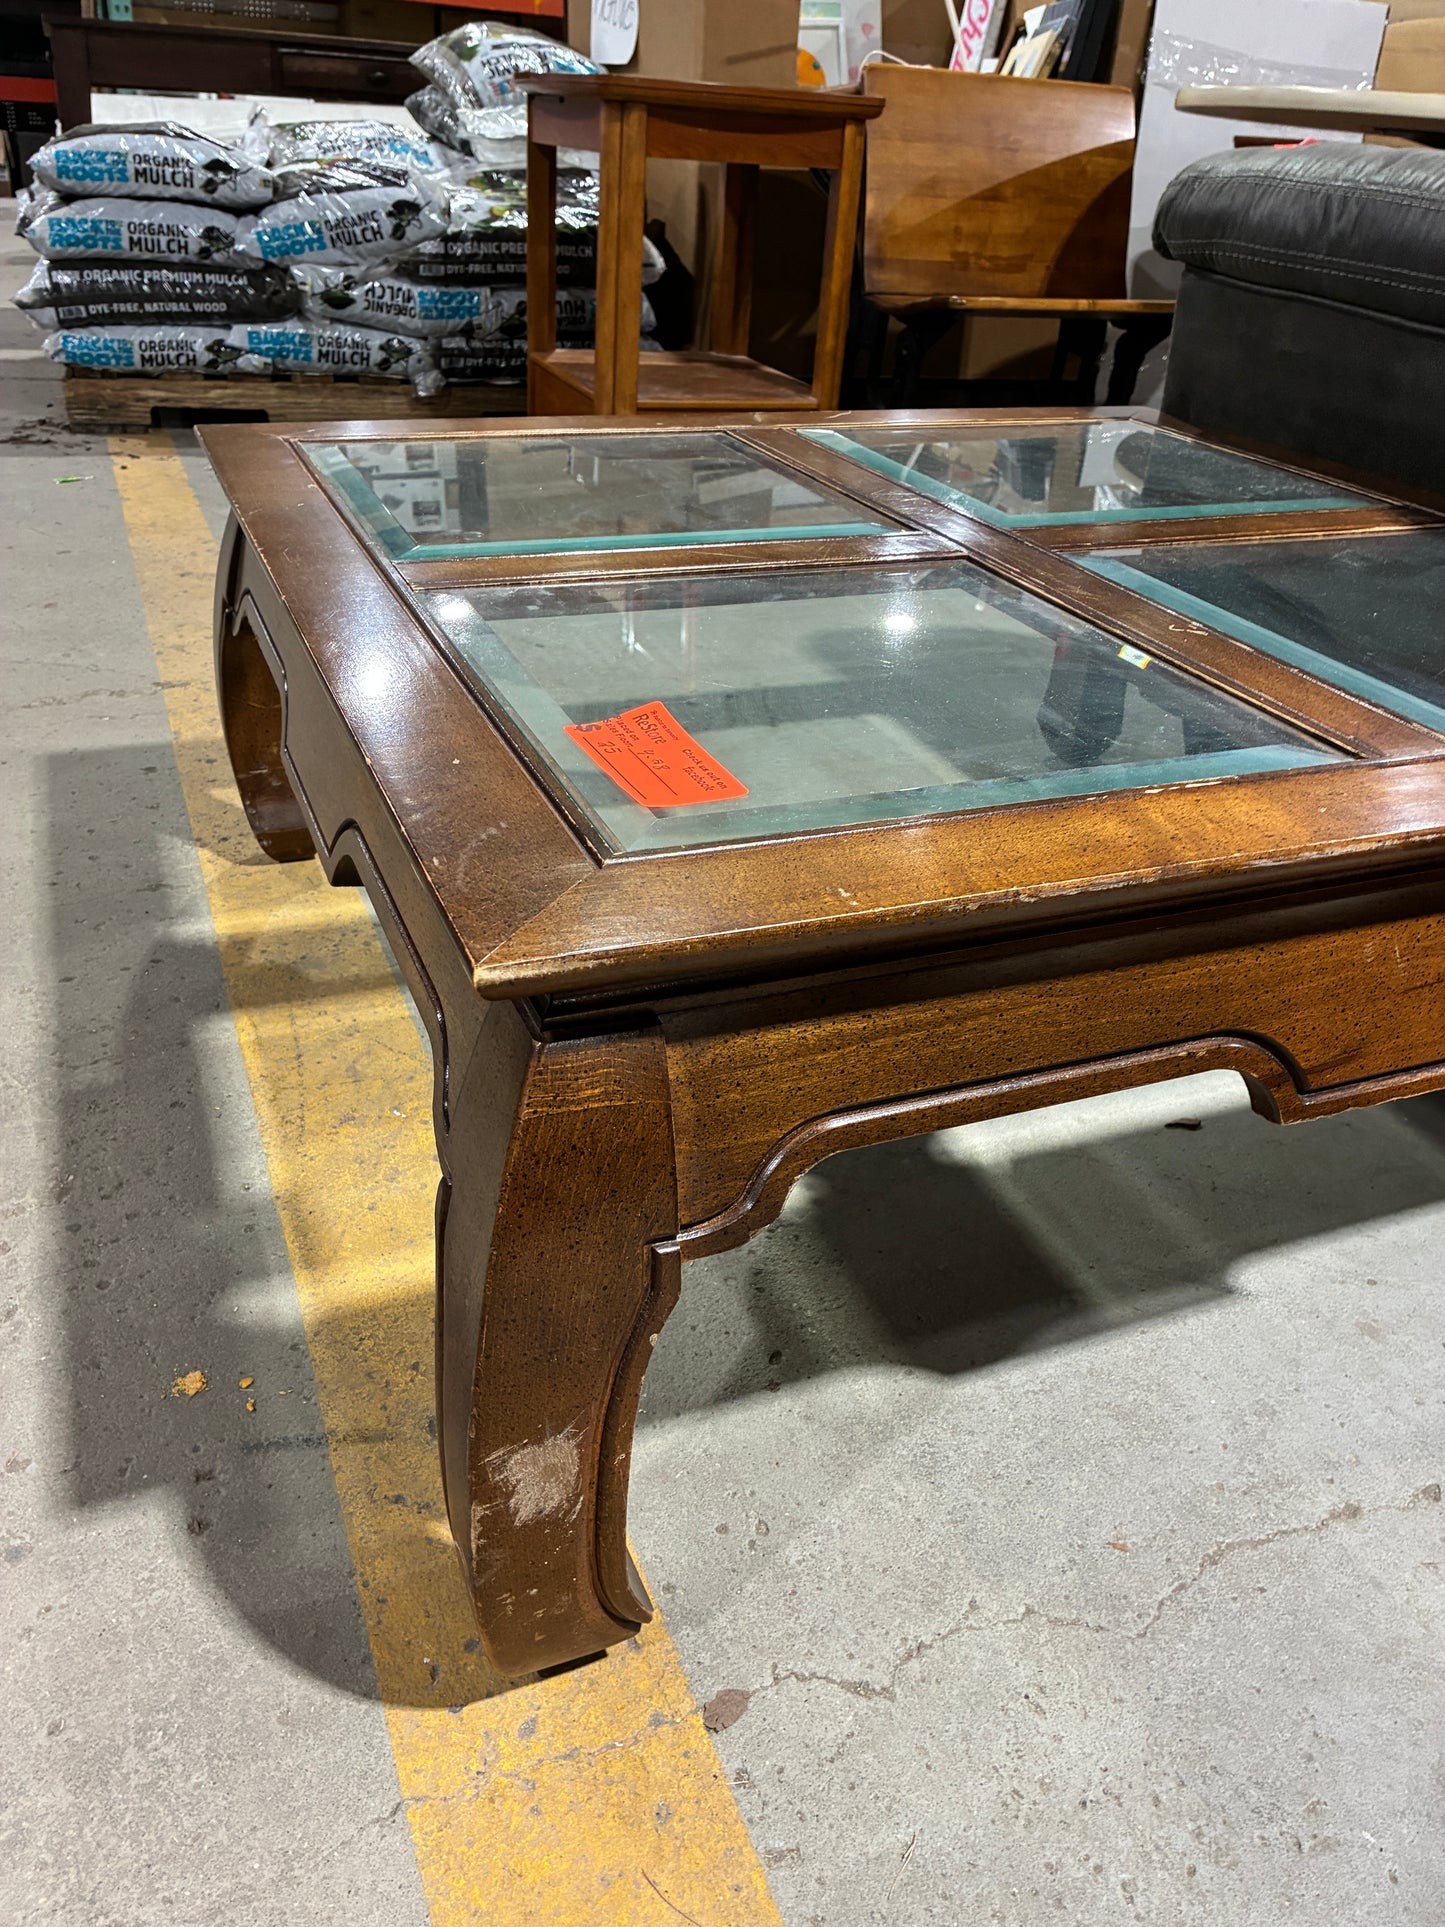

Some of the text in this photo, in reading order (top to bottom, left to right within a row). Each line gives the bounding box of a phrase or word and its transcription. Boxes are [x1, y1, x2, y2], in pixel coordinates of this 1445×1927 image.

[57, 165, 129, 182] ROOTS
[134, 167, 194, 188] MULCH
[127, 221, 189, 238] ORGANIC
[323, 210, 380, 232] ORGANIC
[49, 233, 122, 250] ROOTS
[128, 236, 189, 255] MULCH
[329, 225, 384, 249] MULCH
[260, 235, 327, 259] ROOTS
[447, 242, 499, 255] ORGANIC
[84, 270, 142, 282] ORGANIC
[143, 270, 203, 282] PREMIUM
[205, 273, 248, 285] MULCH
[144, 302, 192, 312] NATURAL
[192, 302, 227, 312] WOOD
[363, 299, 416, 318] ORGANIC
[139, 339, 197, 353] ORGANIC
[317, 334, 371, 351] ORGANIC
[140, 352, 197, 368] MULCH
[317, 349, 371, 366] MULCH
[632, 713, 667, 744] ReStore
[682, 748, 702, 766] Check
[682, 766, 715, 792] facebook
